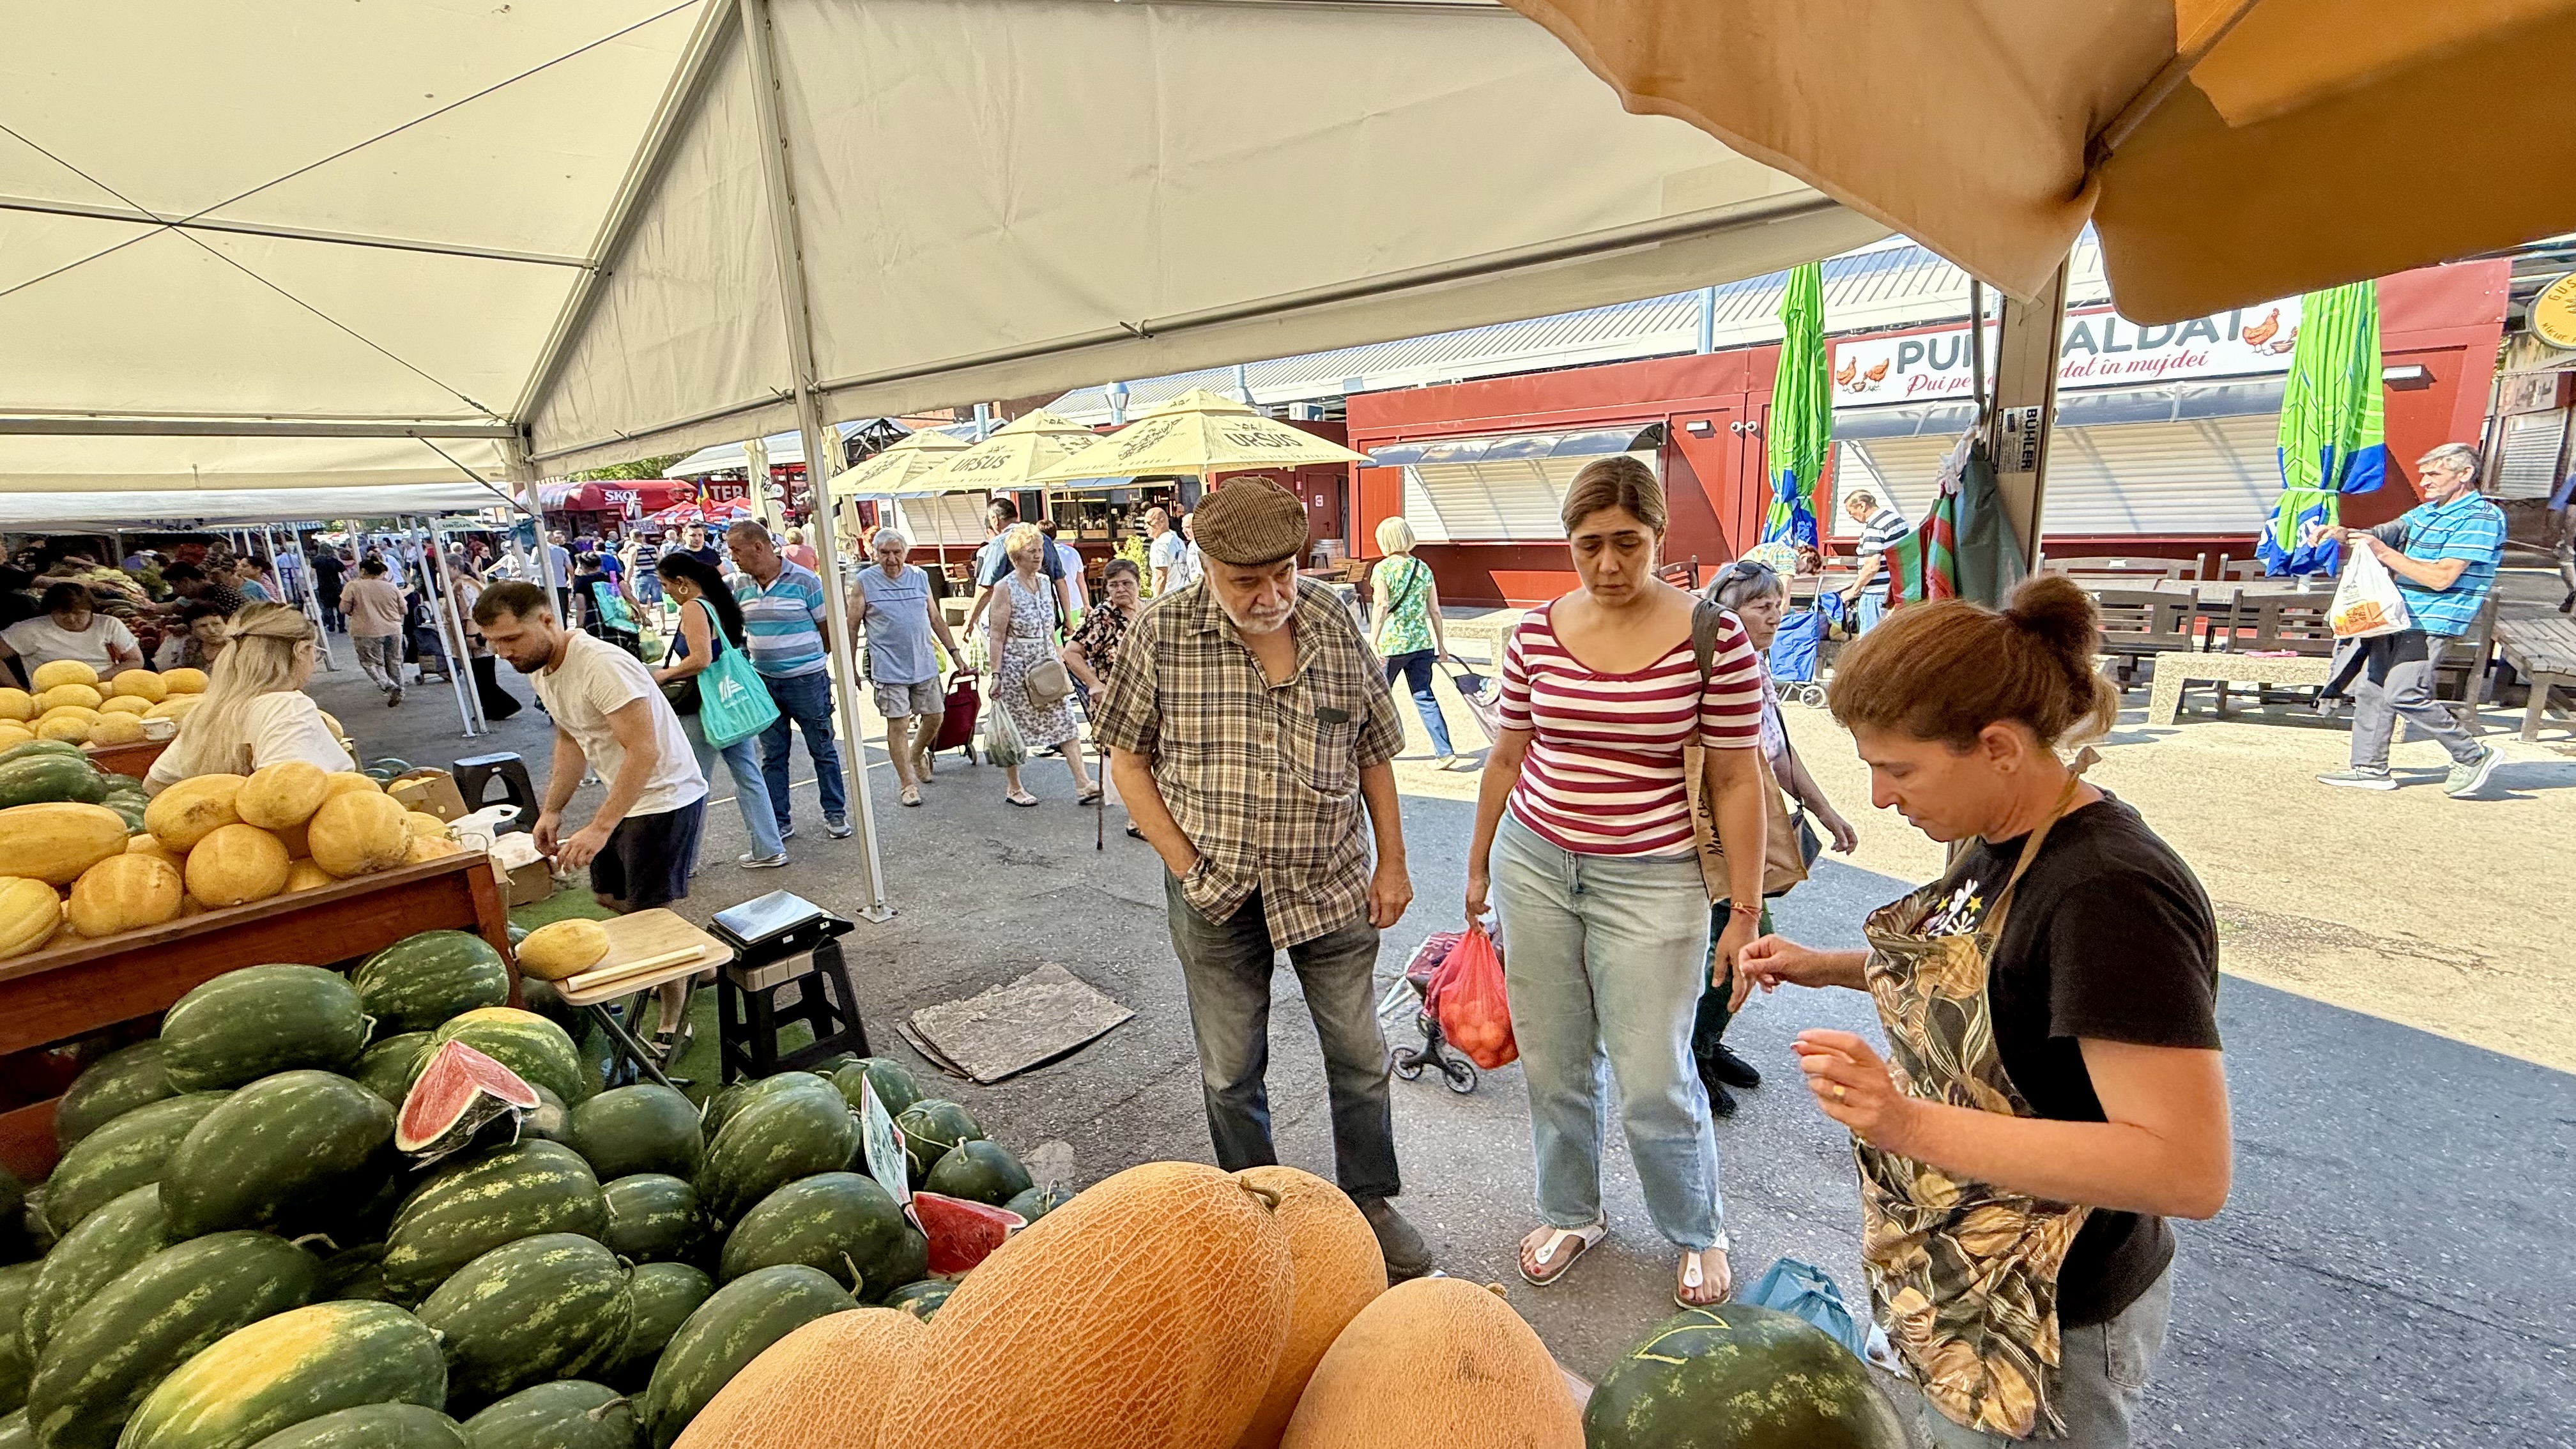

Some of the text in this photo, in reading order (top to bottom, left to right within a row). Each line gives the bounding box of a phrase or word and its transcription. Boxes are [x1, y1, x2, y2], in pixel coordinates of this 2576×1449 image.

[1897, 334, 1972, 374] PUI
[1905, 374, 1946, 397] Pui
[1947, 377, 1971, 393] pe
[2058, 356, 2098, 379] dat
[2100, 358, 2123, 374] în
[2126, 349, 2209, 378] mujdei
[1224, 432, 1303, 448] URSUS
[2021, 408, 2039, 470] BÜHLER
[950, 454, 1011, 473] URSUS
[604, 489, 641, 502] SKOL
